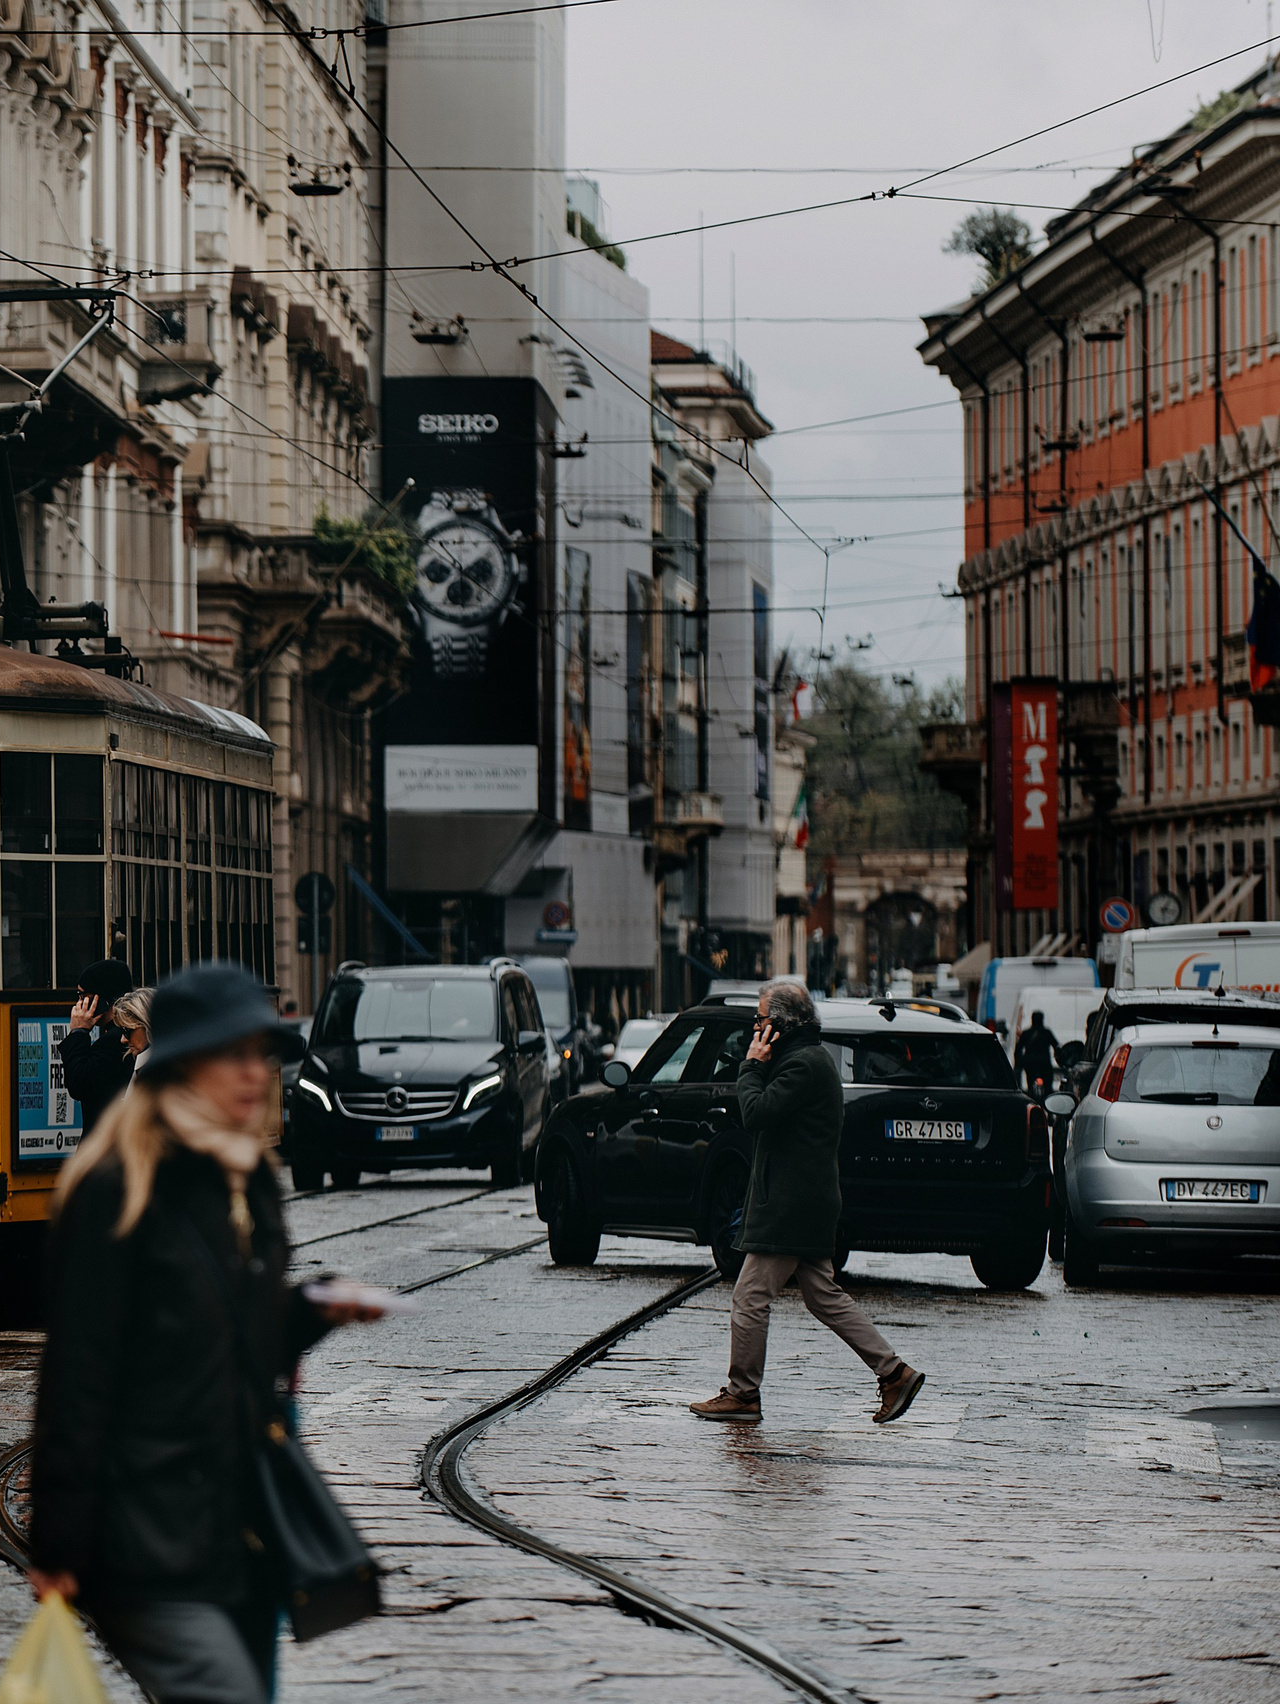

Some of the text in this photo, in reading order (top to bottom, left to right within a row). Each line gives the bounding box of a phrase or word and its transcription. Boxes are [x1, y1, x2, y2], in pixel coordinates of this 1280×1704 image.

[418, 413, 500, 434] SEIKO
[895, 1121, 913, 1137] GR
[854, 1155, 1002, 1165] COUNTRYMAN
[1177, 1182, 1195, 1196] DV
